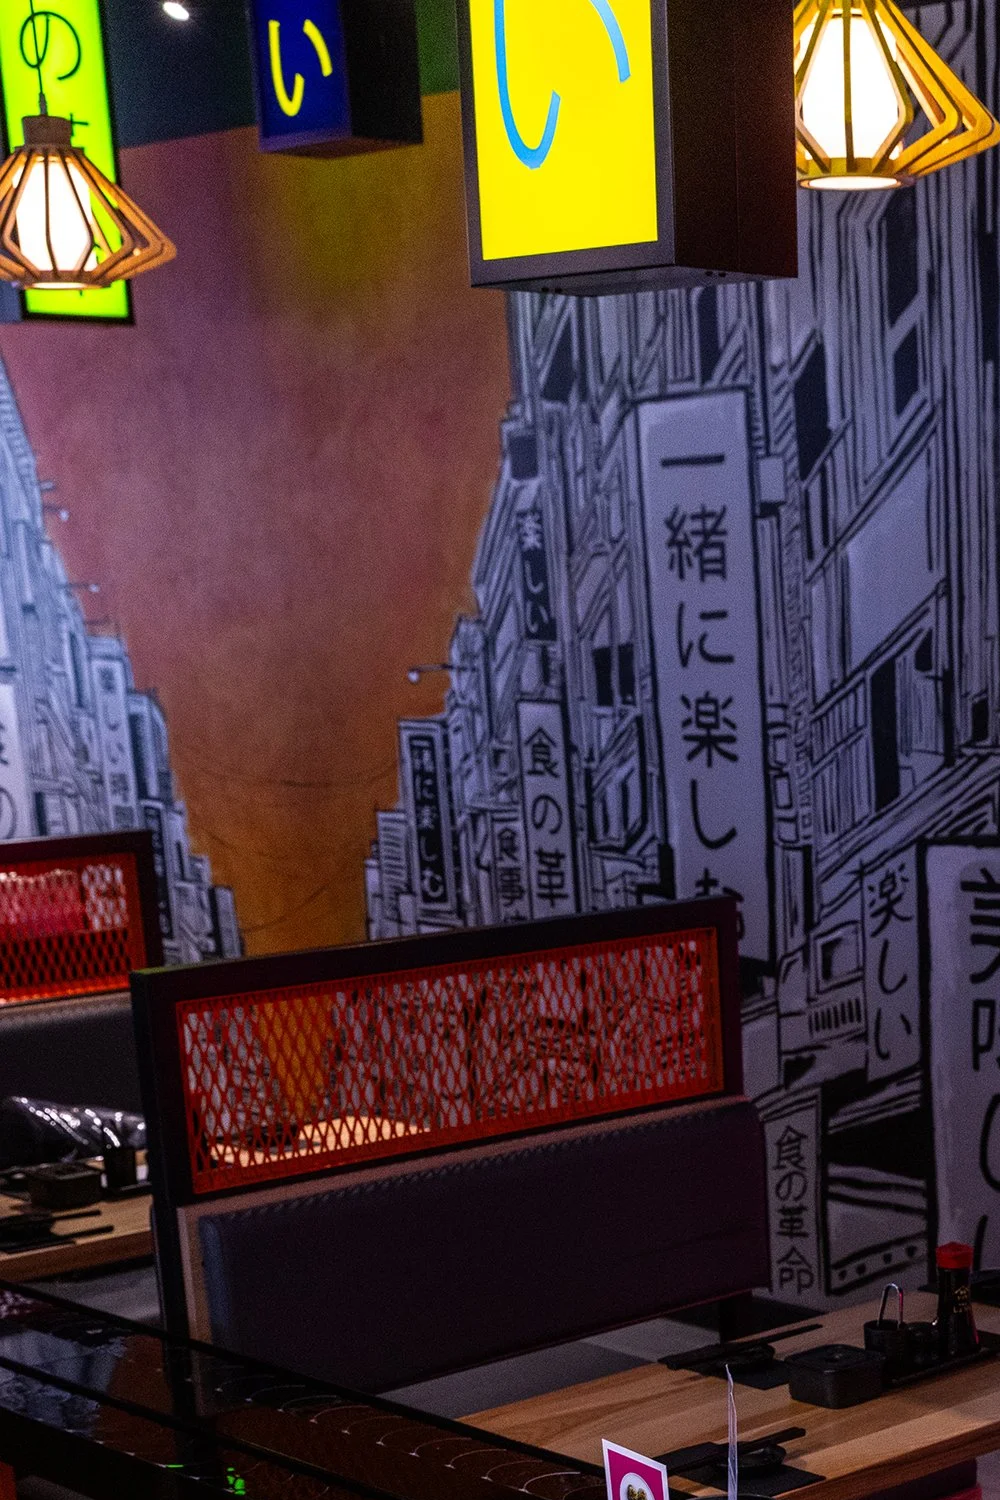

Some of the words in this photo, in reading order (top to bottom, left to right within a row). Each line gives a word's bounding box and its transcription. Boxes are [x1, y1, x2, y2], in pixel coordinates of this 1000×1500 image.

[269, 19, 332, 116] い
[867, 862, 914, 1061] 楽しい
[772, 1124, 815, 1294] 食の革命
